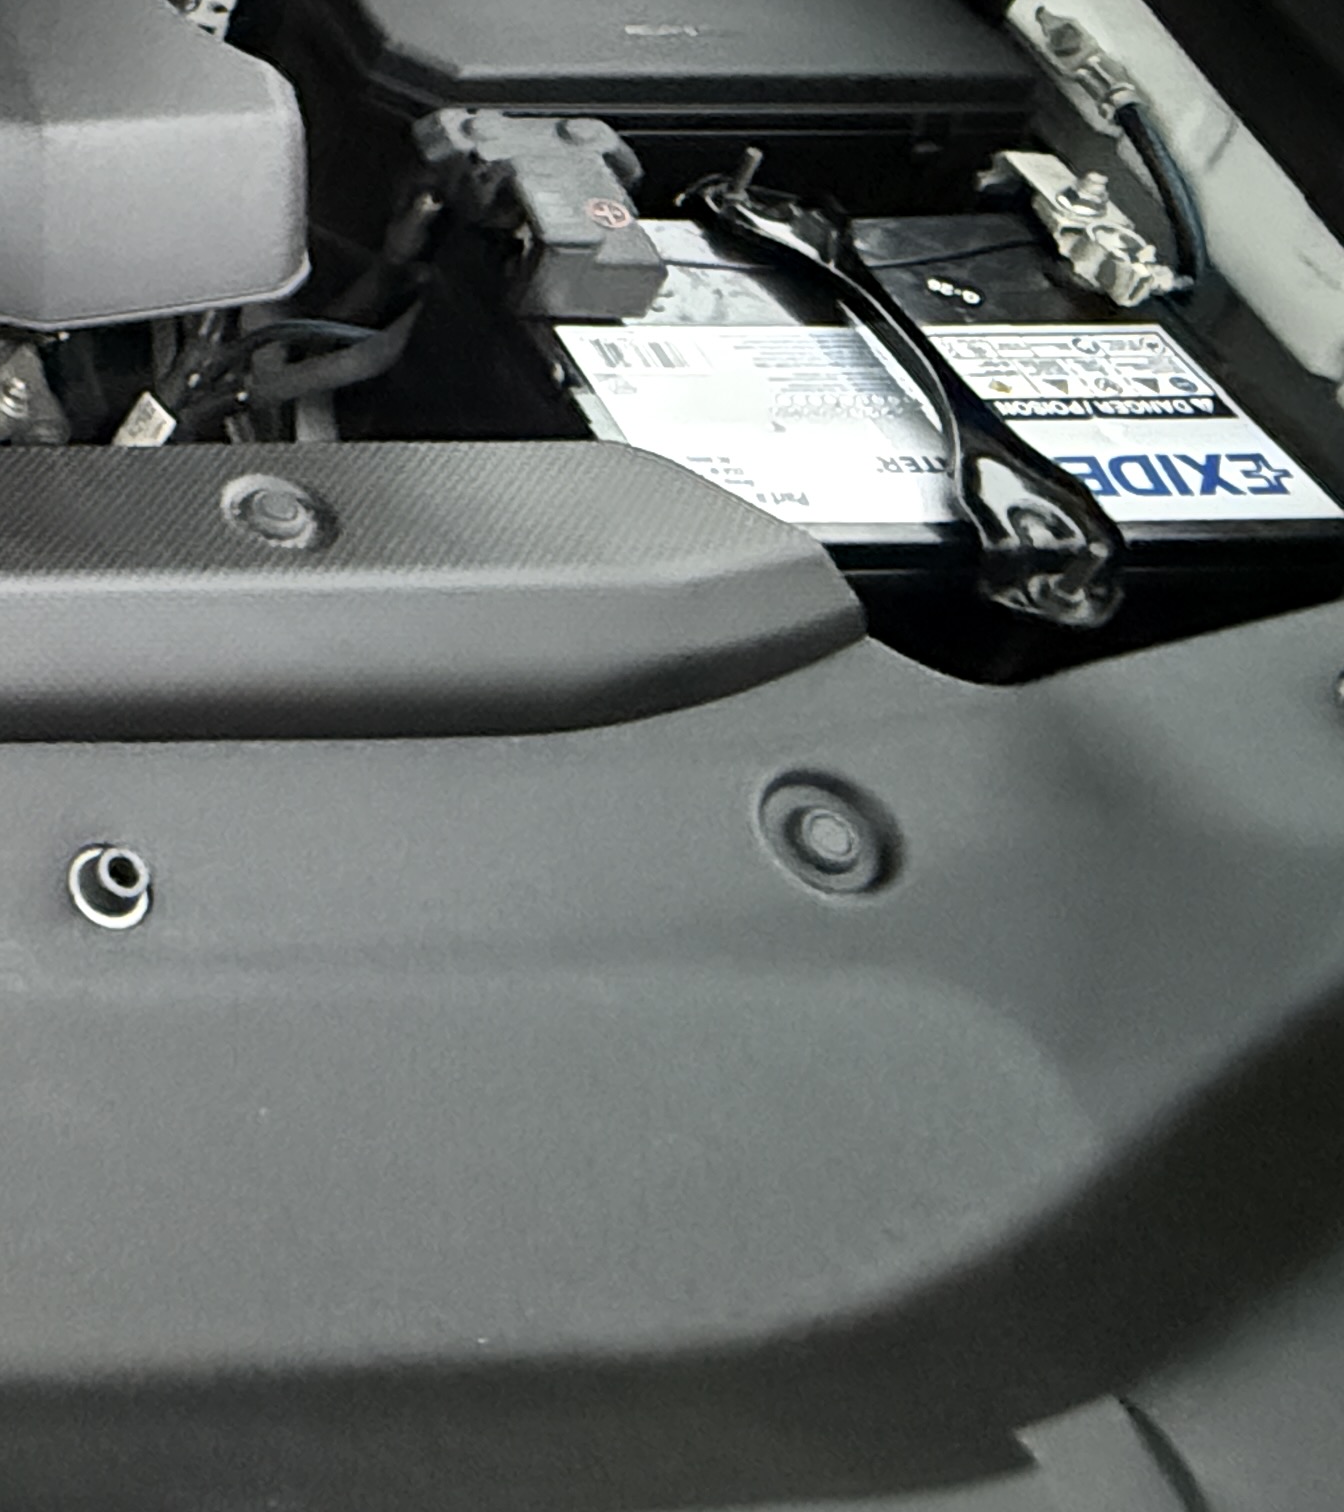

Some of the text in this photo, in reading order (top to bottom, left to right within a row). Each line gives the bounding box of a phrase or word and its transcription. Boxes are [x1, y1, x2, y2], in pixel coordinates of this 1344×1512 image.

[993, 400, 1081, 416] POISON
[1095, 399, 1194, 415] DANGER
[1053, 453, 1293, 496] EXIDE
